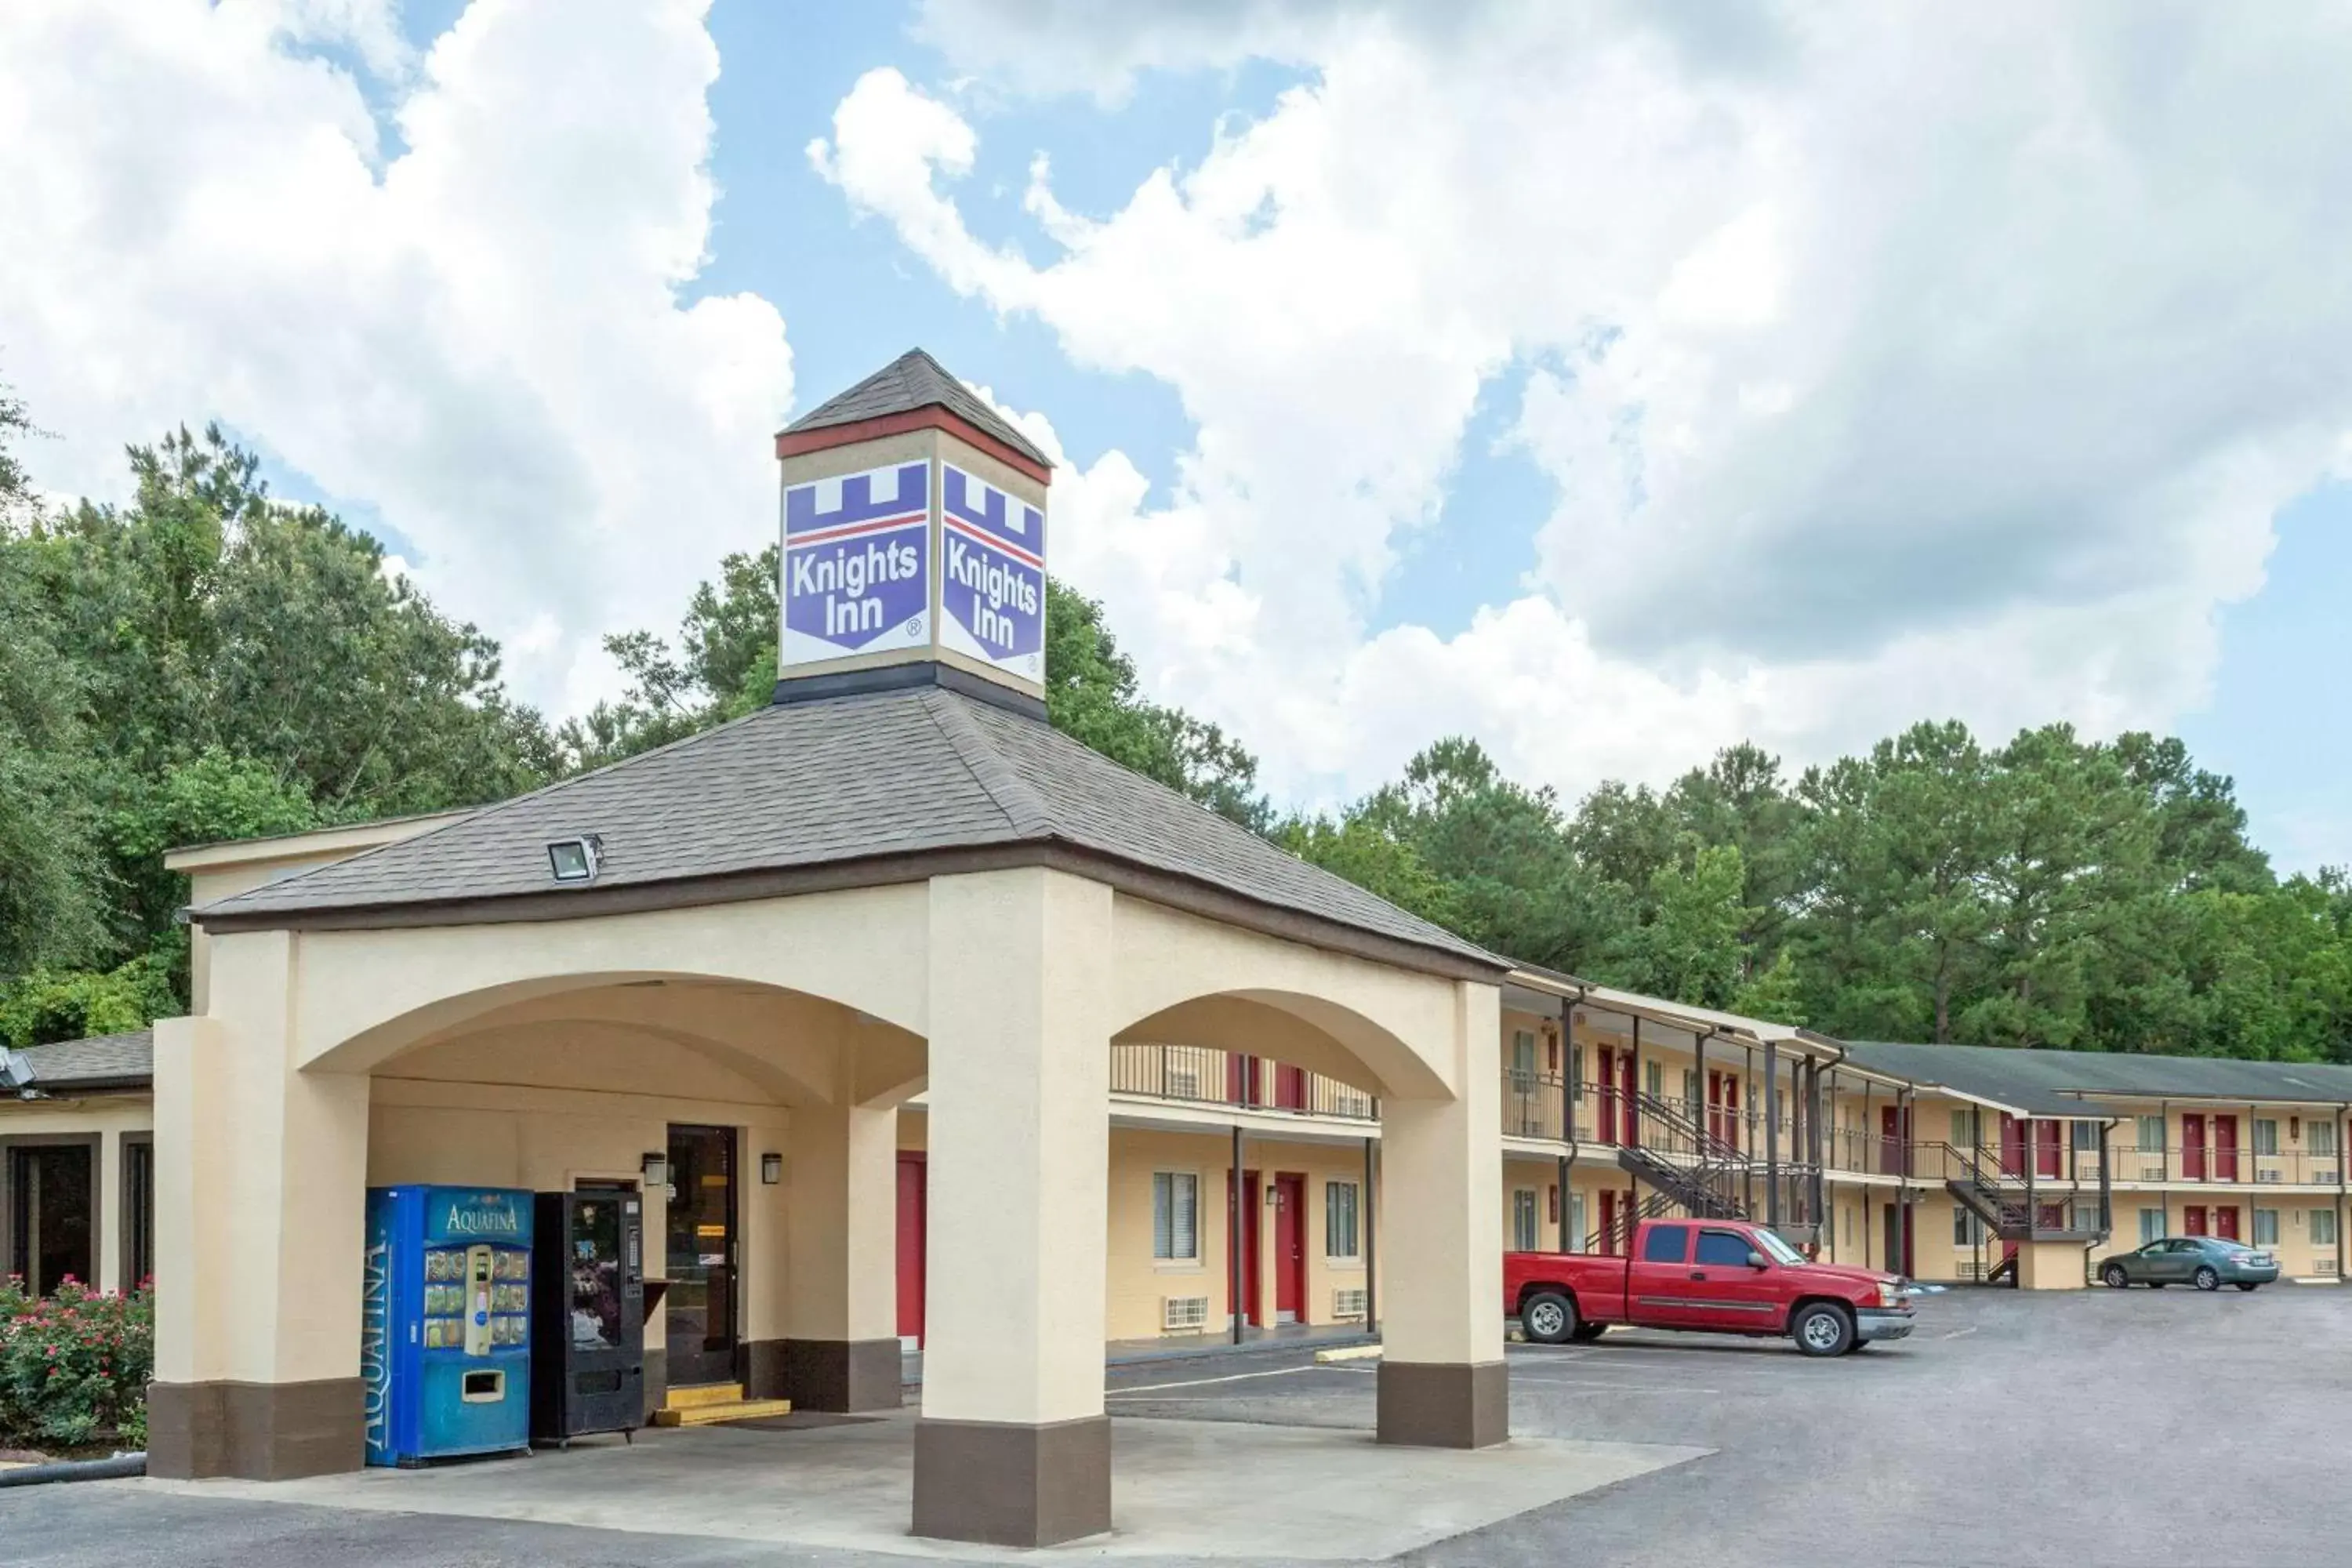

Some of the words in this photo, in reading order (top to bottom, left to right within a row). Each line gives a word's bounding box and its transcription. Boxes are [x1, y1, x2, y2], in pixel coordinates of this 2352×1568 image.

[793, 539, 919, 598] Knights
[949, 537, 1037, 616] Knights
[826, 594, 883, 637] Inn
[973, 593, 1014, 650] Inn
[446, 1203, 517, 1235] AQUAFINA
[363, 1240, 390, 1452] AQUAFINA
